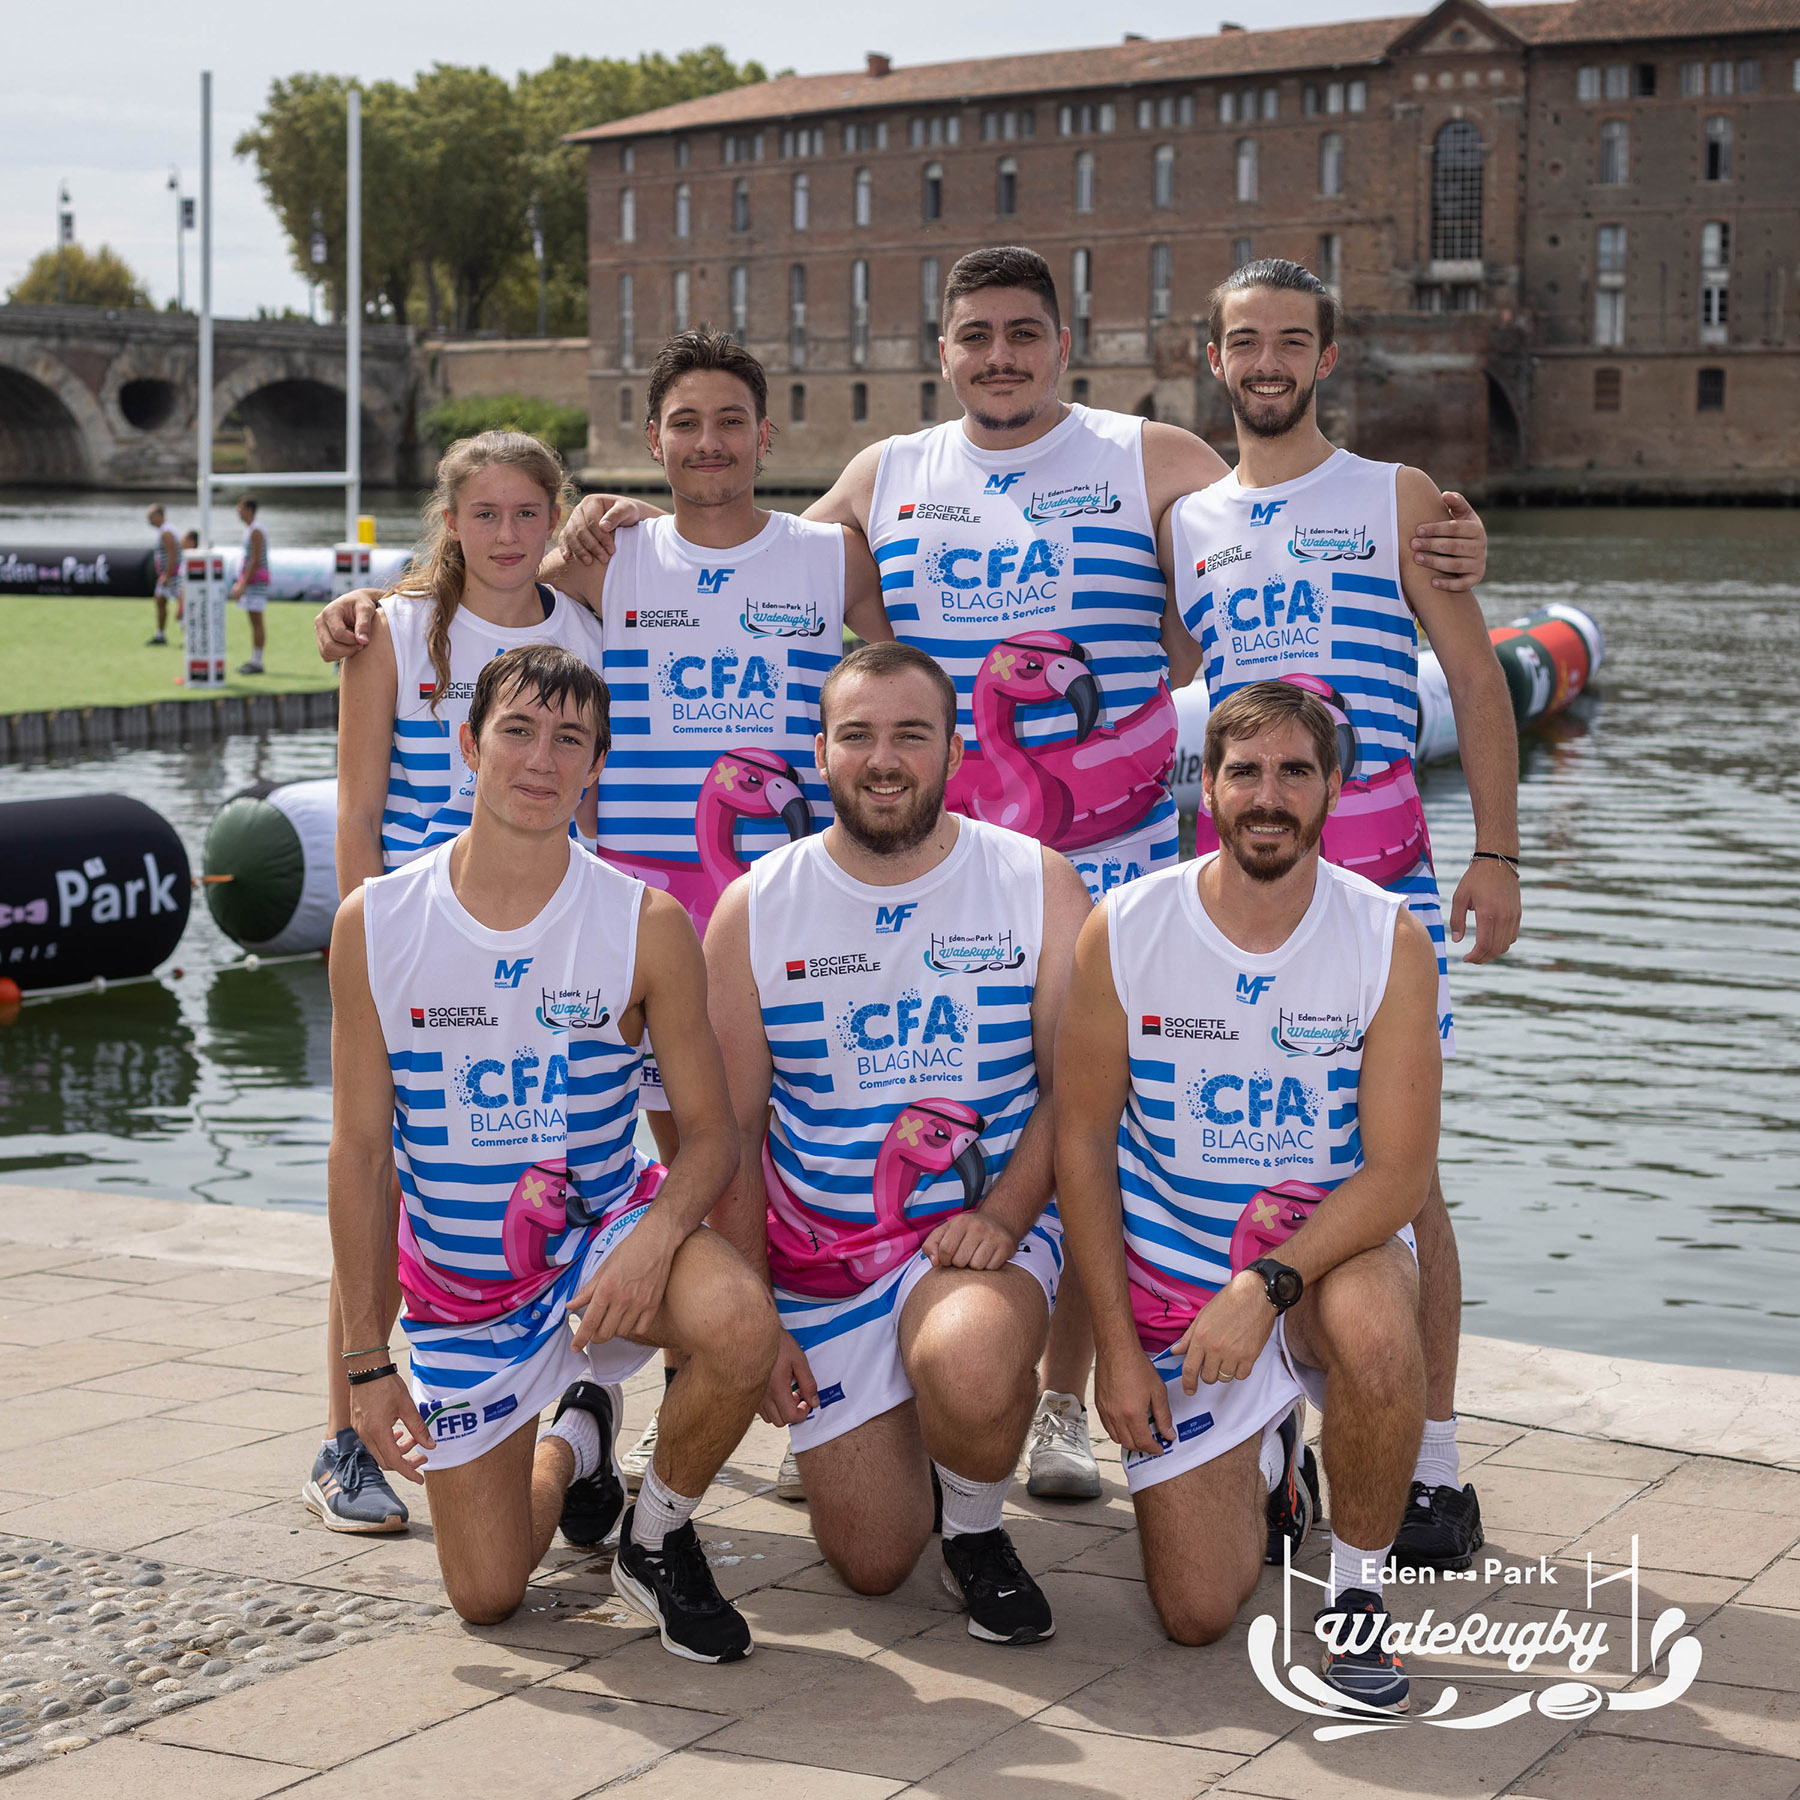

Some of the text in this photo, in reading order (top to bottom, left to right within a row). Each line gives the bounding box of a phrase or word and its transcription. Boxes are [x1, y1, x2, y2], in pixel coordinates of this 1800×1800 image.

[985, 471, 1026, 494] MF
[1047, 485, 1090, 498] Eden Park
[918, 503, 971, 515] SOCIETE
[1037, 493, 1101, 511] WateRugby
[916, 510, 981, 524] GENERALE
[1251, 500, 1288, 525] MF
[1300, 538, 1358, 551] WateRugby
[936, 537, 1062, 590] CFA
[1207, 545, 1242, 565] SOCIETE
[1207, 551, 1252, 573] GENERALE
[62, 554, 110, 584] Park
[697, 569, 736, 594] MF
[941, 581, 1057, 610] BLAGNAC
[640, 610, 688, 618] SOCIETE
[786, 603, 801, 611] Park
[942, 604, 1056, 623] Commerce & Services
[1226, 578, 1322, 632] CFA
[640, 618, 700, 628] GENERALE
[753, 612, 811, 627] WateRugby
[1231, 626, 1320, 654] BLAGNAC
[1235, 654, 1278, 666] Commerce
[1283, 650, 1319, 660] Services
[667, 654, 778, 700] CFA
[672, 702, 774, 720] BLAGNAC
[673, 724, 774, 734] Commerce & Services
[56, 853, 178, 927] Park
[876, 902, 919, 932] MF
[975, 934, 993, 942] Park
[809, 953, 867, 968] SOCIETE
[939, 945, 1005, 960] WateRugby
[494, 957, 535, 988] MF
[810, 961, 881, 978] GENERALE
[1236, 973, 1277, 1005] MF
[428, 1006, 486, 1017] SOCIETE
[1298, 1013, 1343, 1022] Eden Park
[429, 1017, 499, 1028] GENERALE
[848, 994, 967, 1052] CFA
[1164, 1017, 1226, 1029] SOCIETE
[1164, 1028, 1240, 1041] GENERALE
[857, 1048, 963, 1075] BLAGNAC
[464, 1054, 568, 1109] CFA
[859, 1072, 963, 1090] Commerce & Services
[1198, 1073, 1317, 1128] CFA
[471, 1109, 567, 1132] BLAGNA
[471, 1135, 529, 1147] Commerce
[531, 1134, 539, 1143] &
[1202, 1127, 1314, 1152] BLAGNAC
[1202, 1153, 1314, 1167] Commerce & Services
[436, 1412, 478, 1437] FFB
